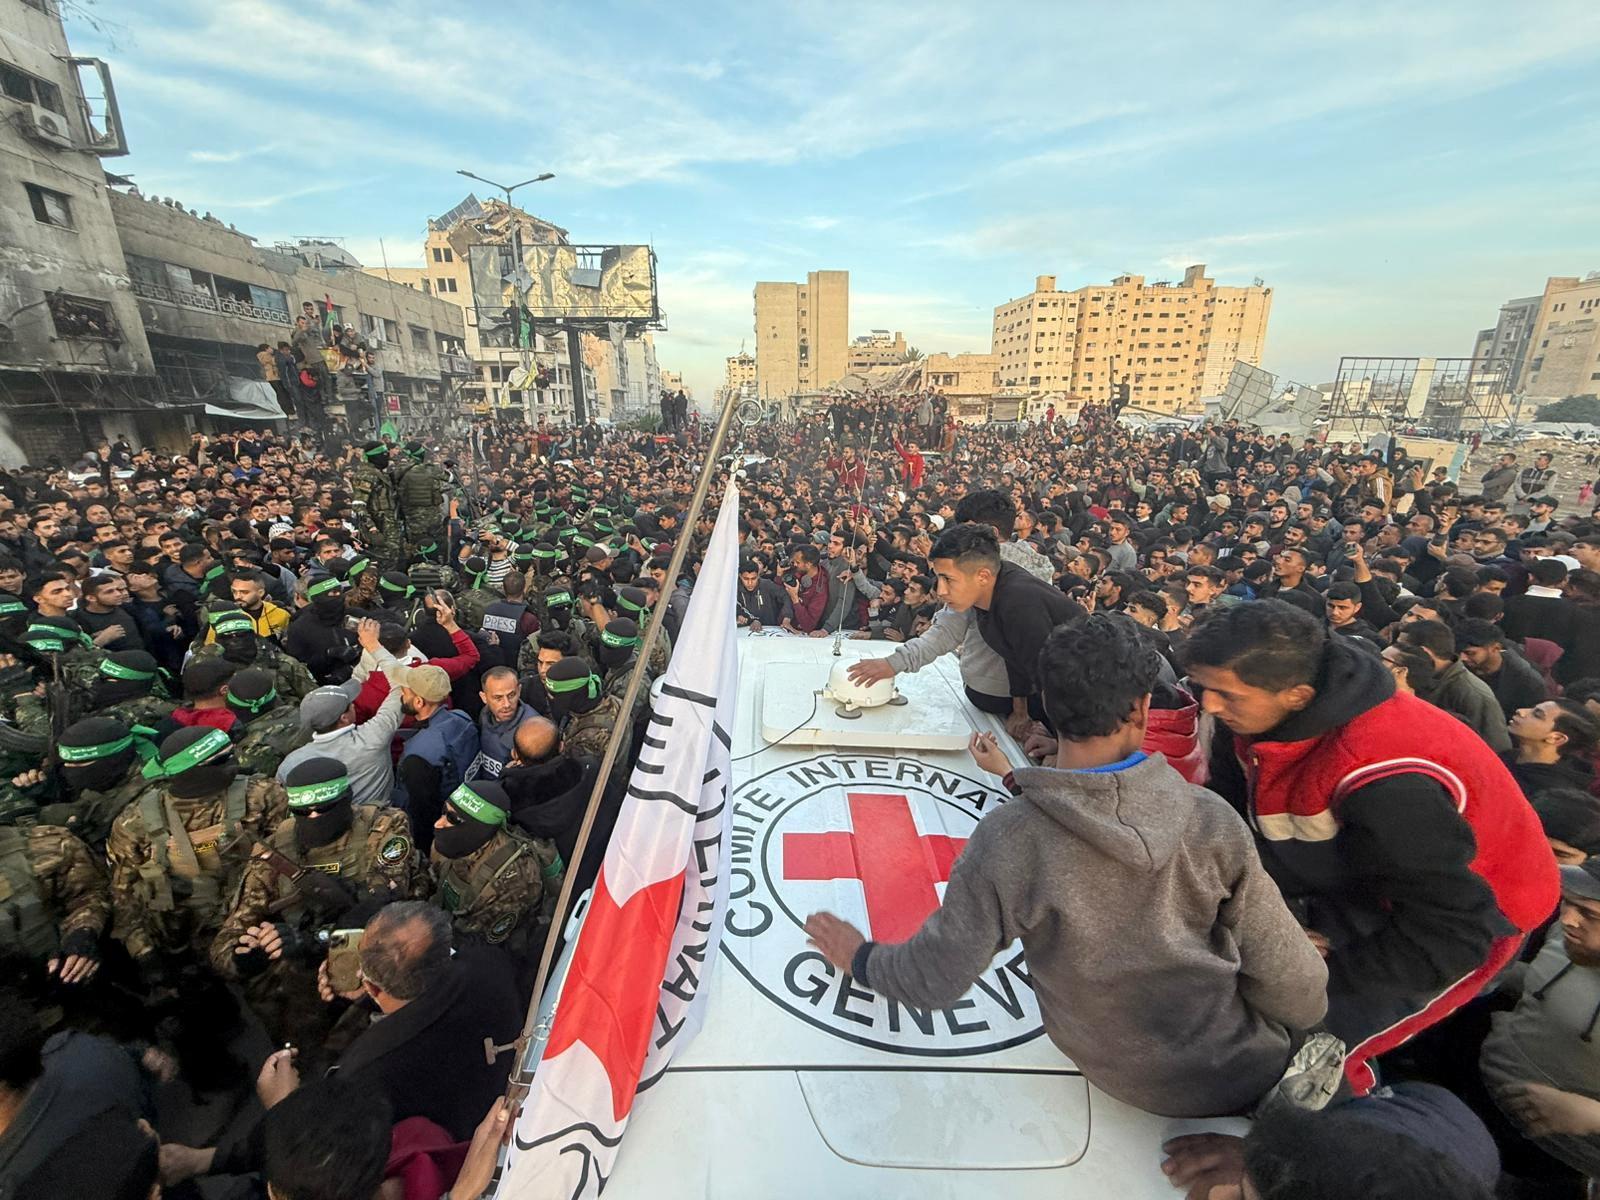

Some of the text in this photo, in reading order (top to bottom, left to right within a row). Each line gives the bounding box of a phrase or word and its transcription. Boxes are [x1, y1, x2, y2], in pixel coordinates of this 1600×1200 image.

[484, 615, 515, 631] PRESS
[482, 756, 502, 776] ESS
[787, 759, 1006, 811] INTERNA
